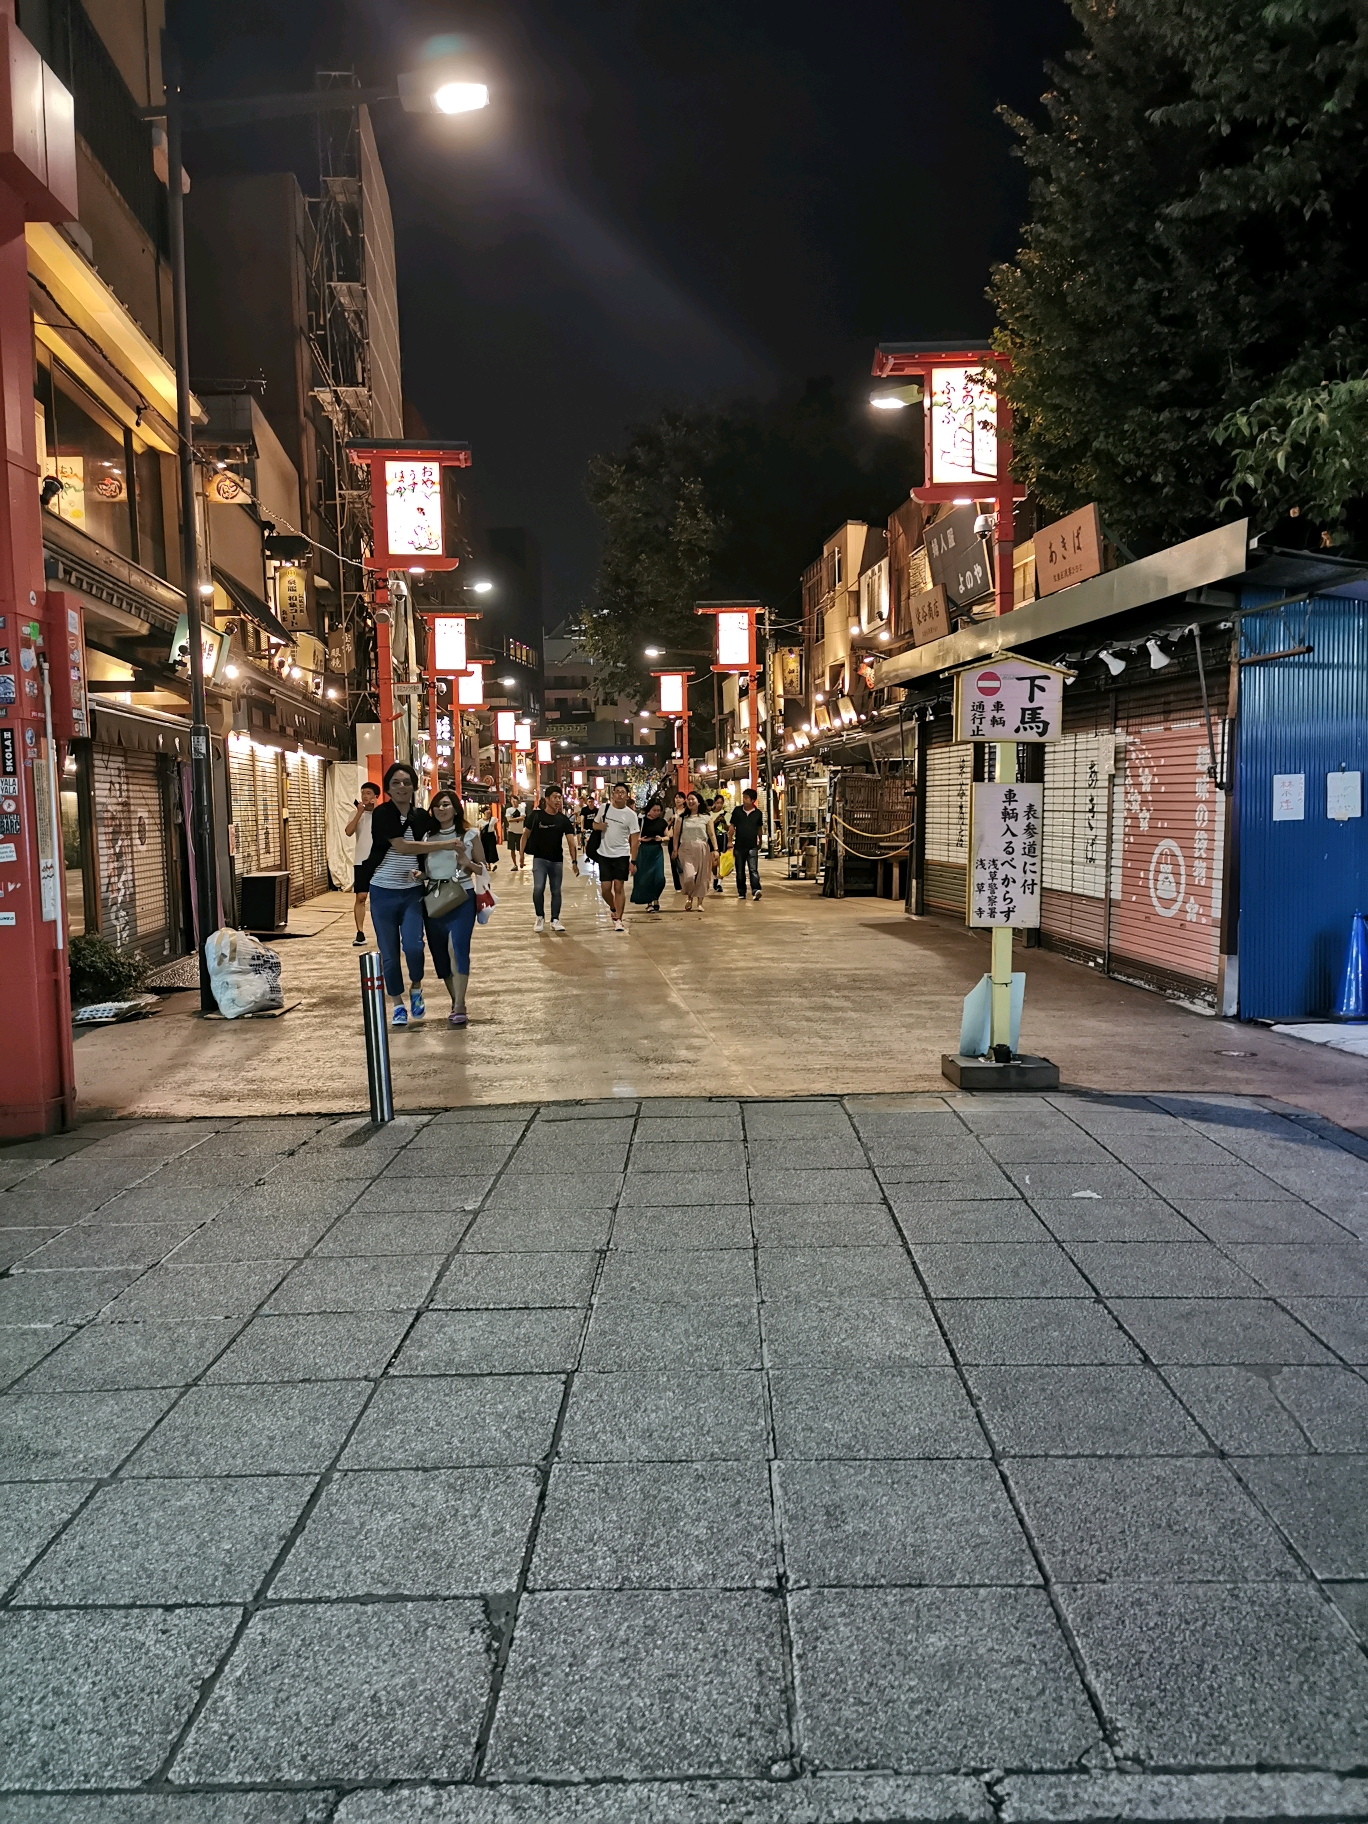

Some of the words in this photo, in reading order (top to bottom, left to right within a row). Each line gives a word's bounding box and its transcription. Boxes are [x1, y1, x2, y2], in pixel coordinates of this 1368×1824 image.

[958, 562, 983, 594] よのや
[969, 700, 987, 737] 通行止
[1013, 674, 1052, 738] 下馬
[1019, 802, 1041, 896] 表参道に付
[986, 857, 1000, 920] 浅草警察署
